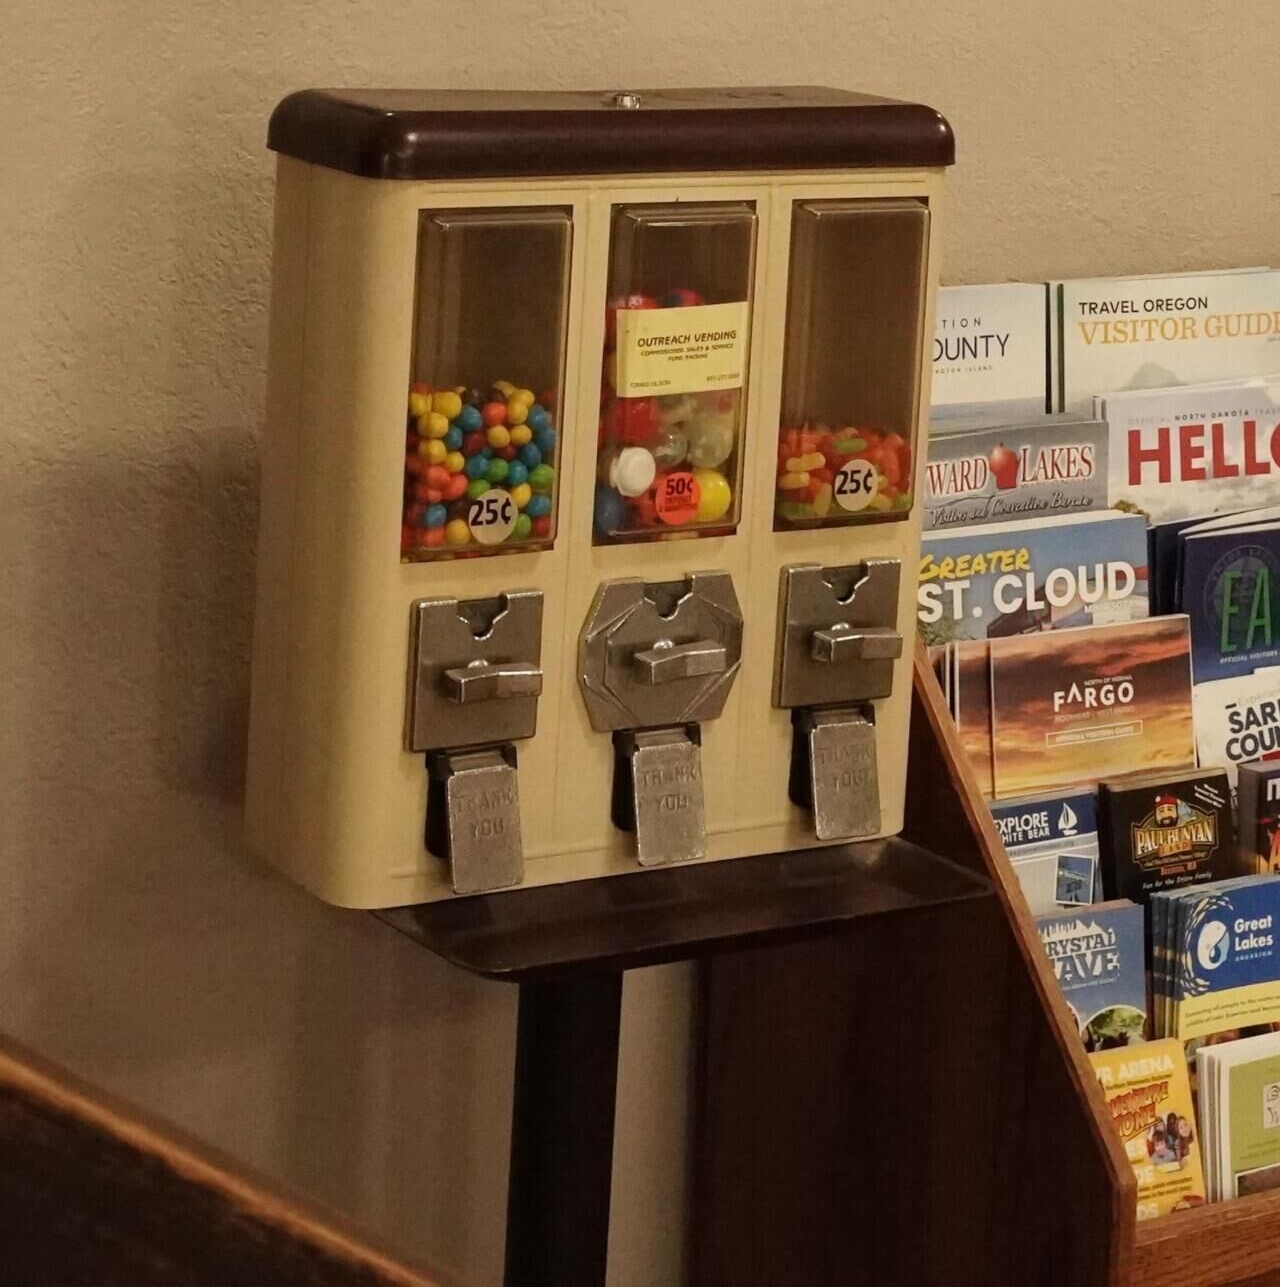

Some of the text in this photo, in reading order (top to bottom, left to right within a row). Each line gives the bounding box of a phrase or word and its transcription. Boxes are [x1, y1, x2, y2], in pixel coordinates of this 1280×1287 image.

[1079, 297, 1208, 314] TRAVEL OREGON
[637, 330, 736, 347] OUTREACH VENDING
[1078, 316, 1196, 345] VISITOR
[1174, 413, 1206, 422] NORTH
[1211, 409, 1249, 419] DAKOTA
[1021, 446, 1093, 482] LAKES
[836, 468, 872, 495] 25¢
[470, 497, 511, 526] 25¢
[919, 548, 1030, 581] GREATER
[917, 561, 1135, 624] ST. CLOUD
[1220, 654, 1247, 664] OFFICIAL
[1250, 650, 1278, 660] VISITORS
[1054, 681, 1134, 713] FARGO
[820, 746, 874, 765] THANK
[640, 766, 700, 788] THANK
[832, 771, 867, 789] YOU
[457, 791, 518, 813] THANK
[654, 794, 688, 811] YOU
[470, 817, 505, 840] YOU
[1001, 827, 1050, 843] HITE BEAR
[1136, 820, 1213, 855] PAUL BUNYAN
[1195, 871, 1212, 881] Family
[1234, 915, 1272, 933] Great
[1235, 933, 1273, 951] Lakes
[1118, 1054, 1175, 1081] ARENA
